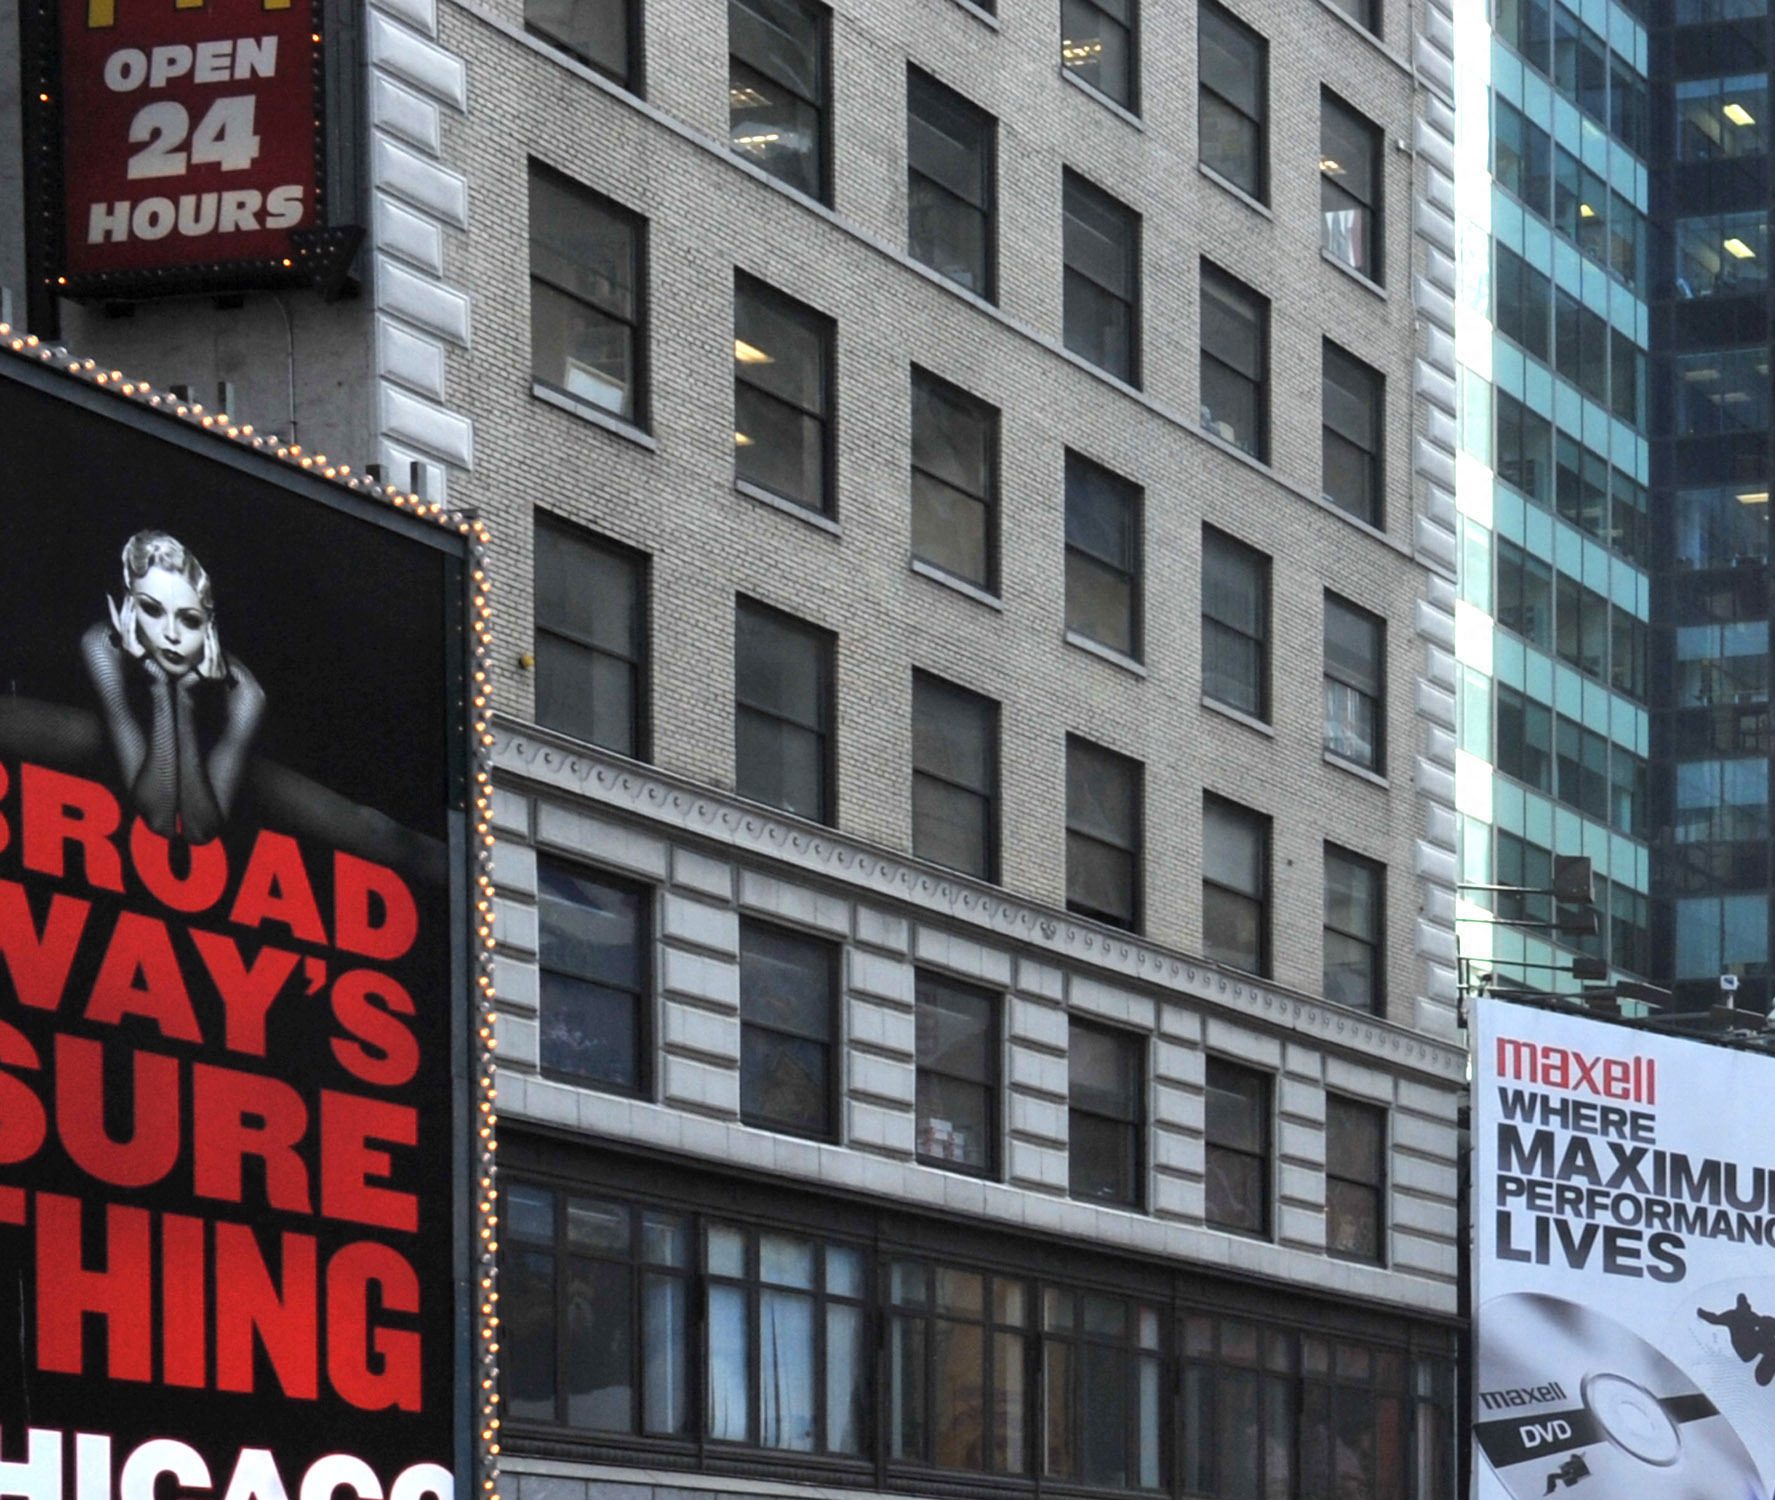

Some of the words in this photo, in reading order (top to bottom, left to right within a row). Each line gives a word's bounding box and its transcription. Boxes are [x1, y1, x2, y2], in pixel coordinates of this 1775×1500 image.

[104, 36, 278, 92] OPEN
[127, 95, 260, 180] 24
[87, 186, 304, 244] HOURS
[0, 760, 418, 961] ROAD
[1497, 1036, 1656, 1106] maxell
[1499, 1086, 1656, 1146] WHERE
[1496, 1210, 1686, 1283] LIVES
[1480, 1381, 1567, 1411] maxell
[1519, 1418, 1572, 1450] DVD
